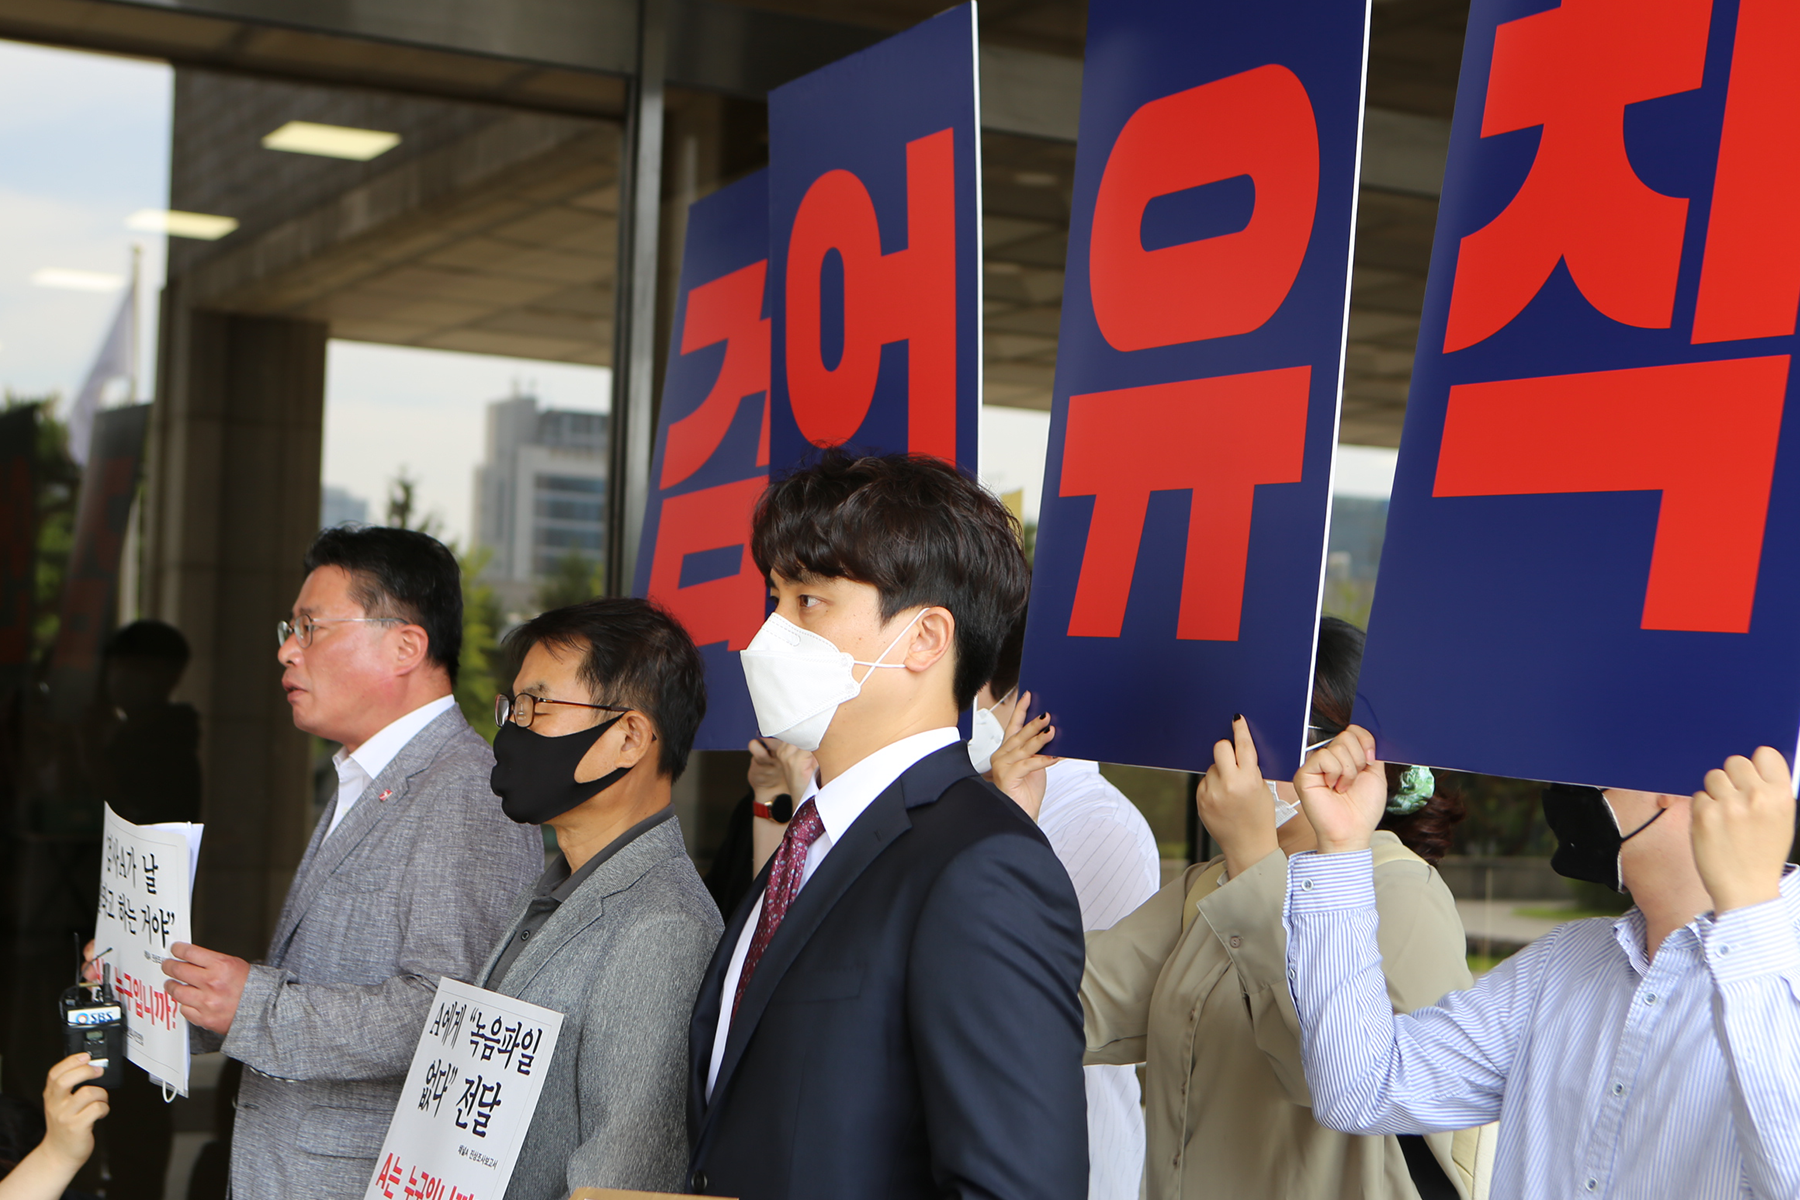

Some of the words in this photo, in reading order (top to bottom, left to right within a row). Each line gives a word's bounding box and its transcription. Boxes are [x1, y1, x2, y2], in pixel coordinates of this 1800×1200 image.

[1058, 64, 1320, 642] 유
[142, 852, 158, 895] 날
[118, 893, 137, 935] 하는
[90, 1011, 113, 1025] SBS
[114, 966, 178, 1031] 누구입니까?
[429, 1001, 467, 1049] A에게
[455, 1074, 502, 1138] 전달
[375, 1152, 403, 1200] A는
